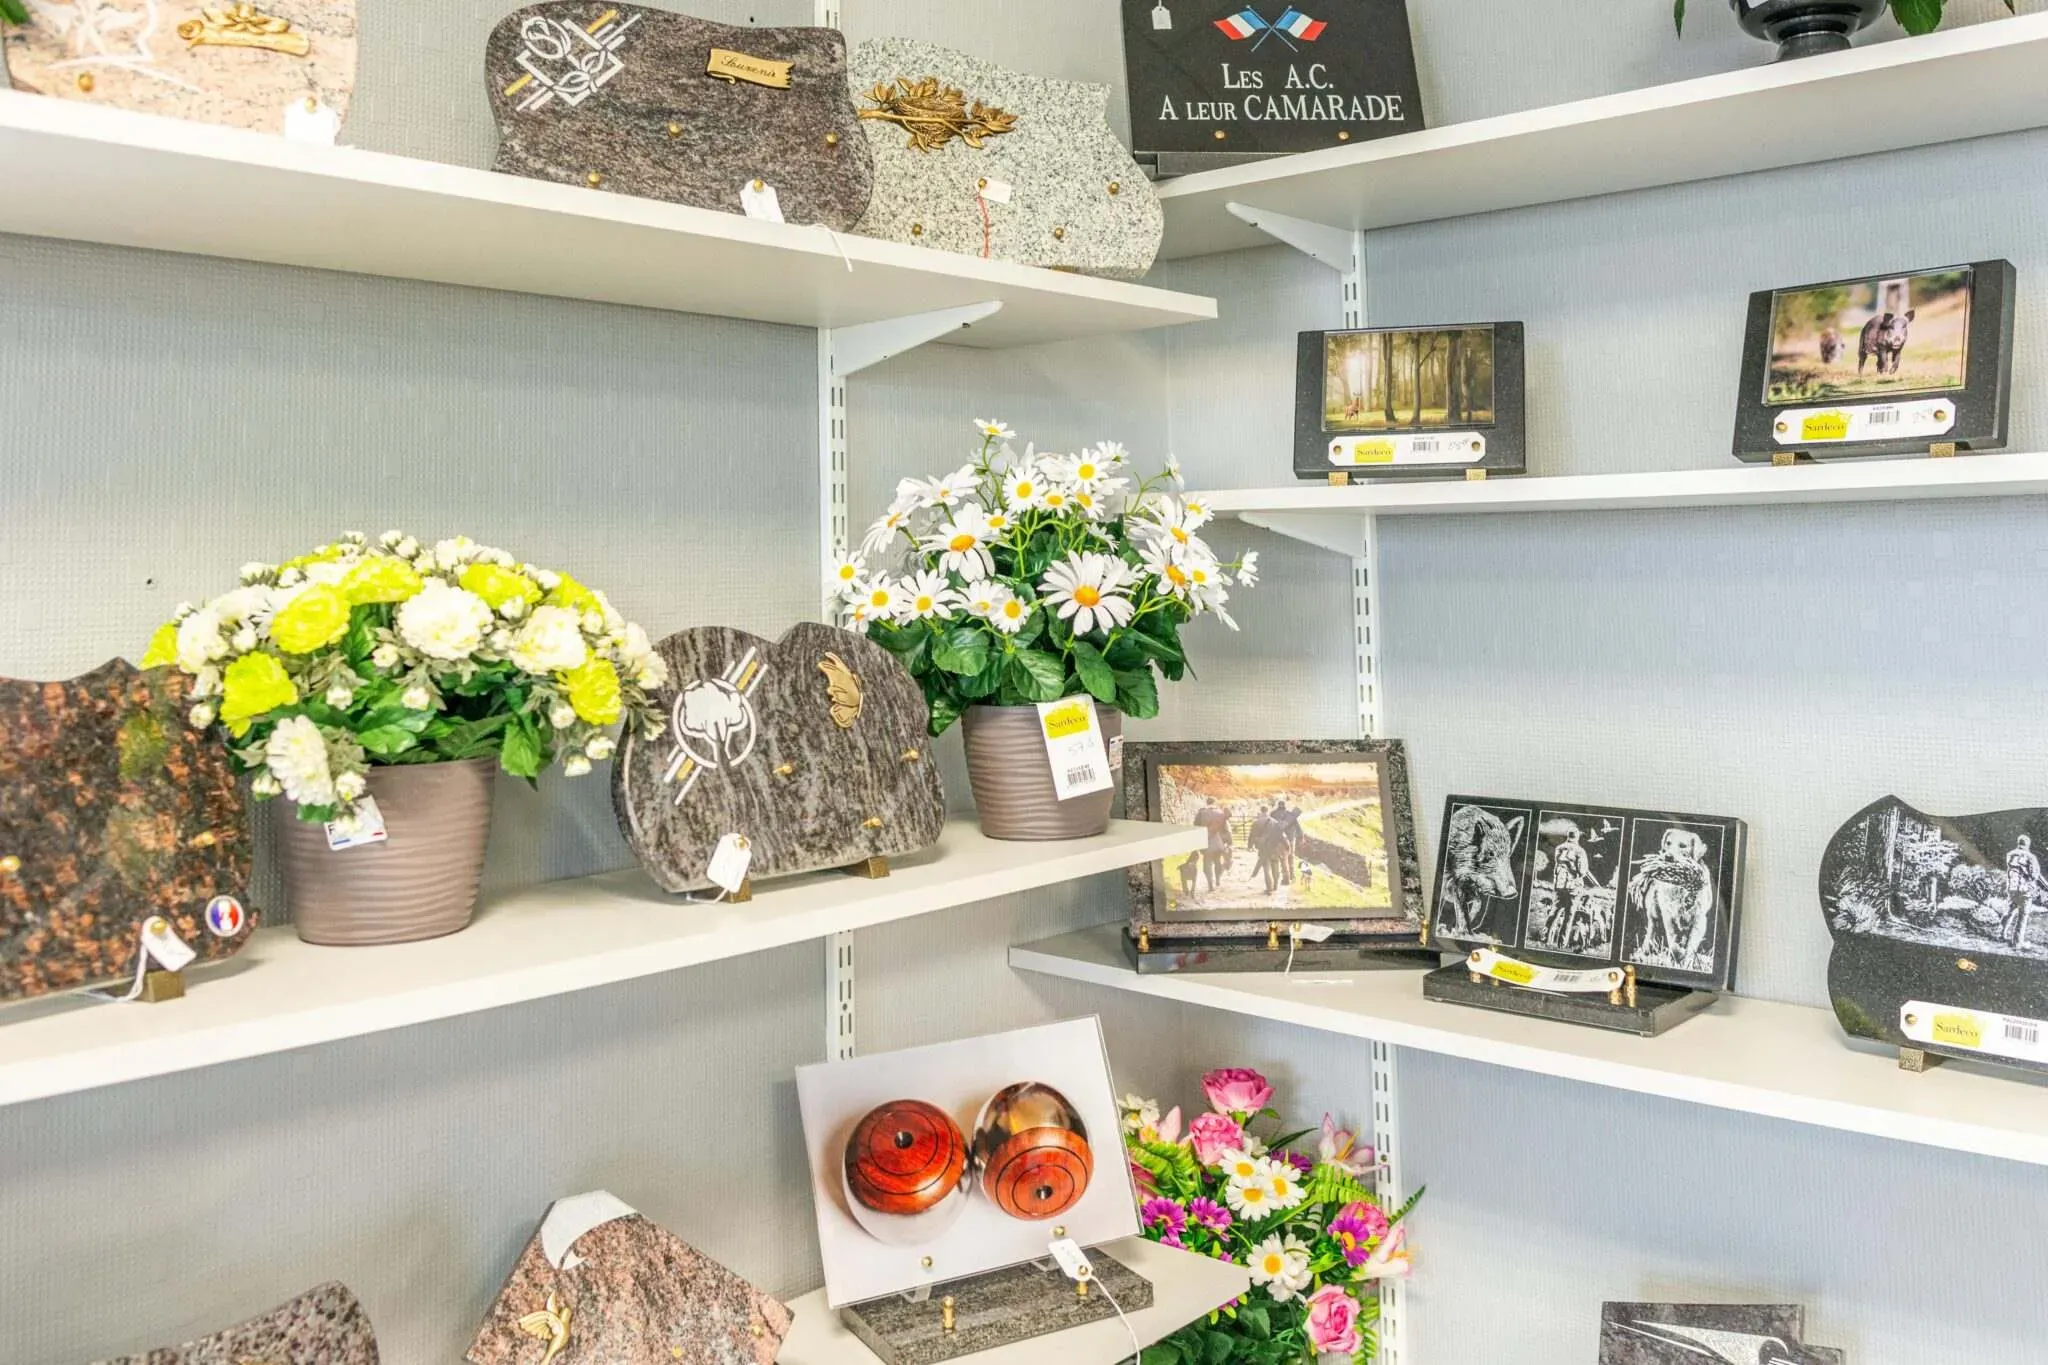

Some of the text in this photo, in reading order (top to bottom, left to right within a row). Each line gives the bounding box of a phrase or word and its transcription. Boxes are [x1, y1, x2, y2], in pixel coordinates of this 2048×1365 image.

[1285, 63, 1334, 89] A.C.
[1159, 95, 1179, 121] A
[1244, 94, 1405, 121] CAMARADE
